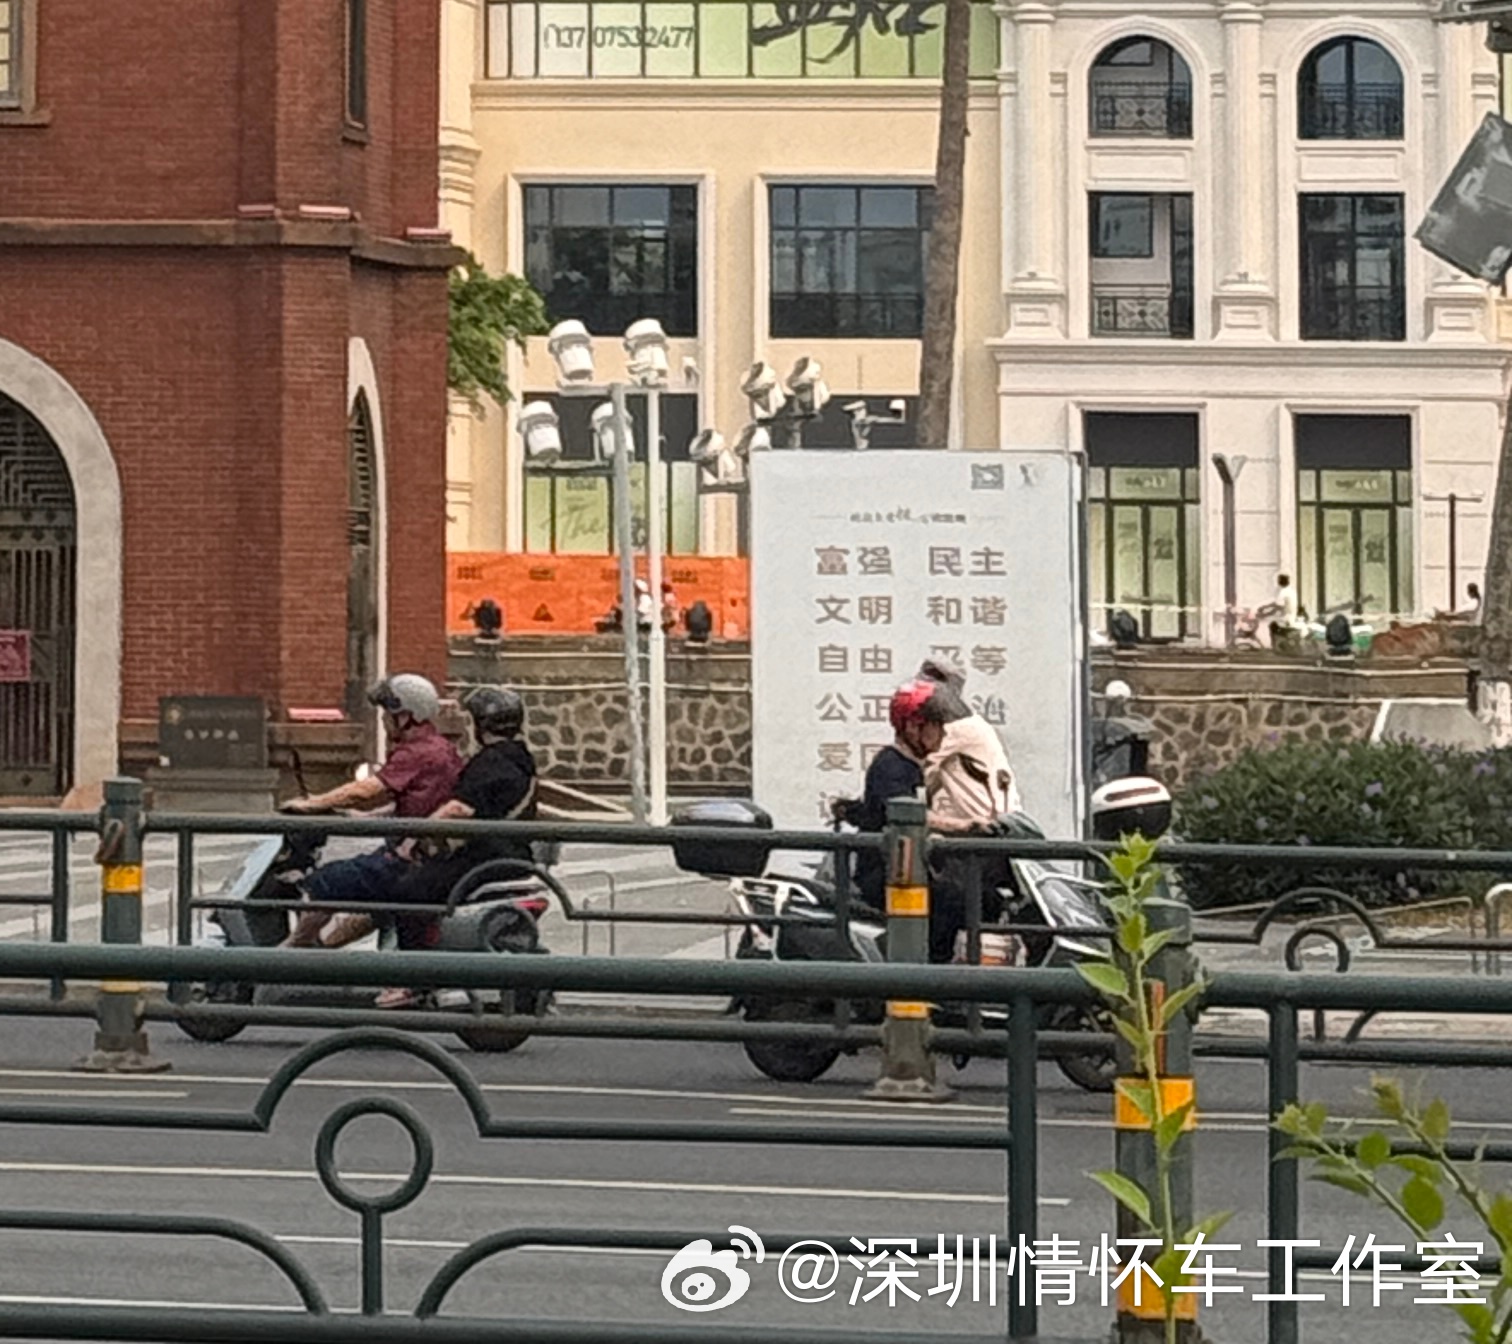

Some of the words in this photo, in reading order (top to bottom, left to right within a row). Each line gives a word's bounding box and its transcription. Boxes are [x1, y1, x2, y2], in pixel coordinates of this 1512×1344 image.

[814, 545, 893, 577] 富强
[928, 545, 1008, 577] 民主
[814, 594, 893, 626] 文明
[926, 595, 1008, 627] 和谐
[818, 643, 893, 674] 自由
[814, 692, 891, 723] 公正
